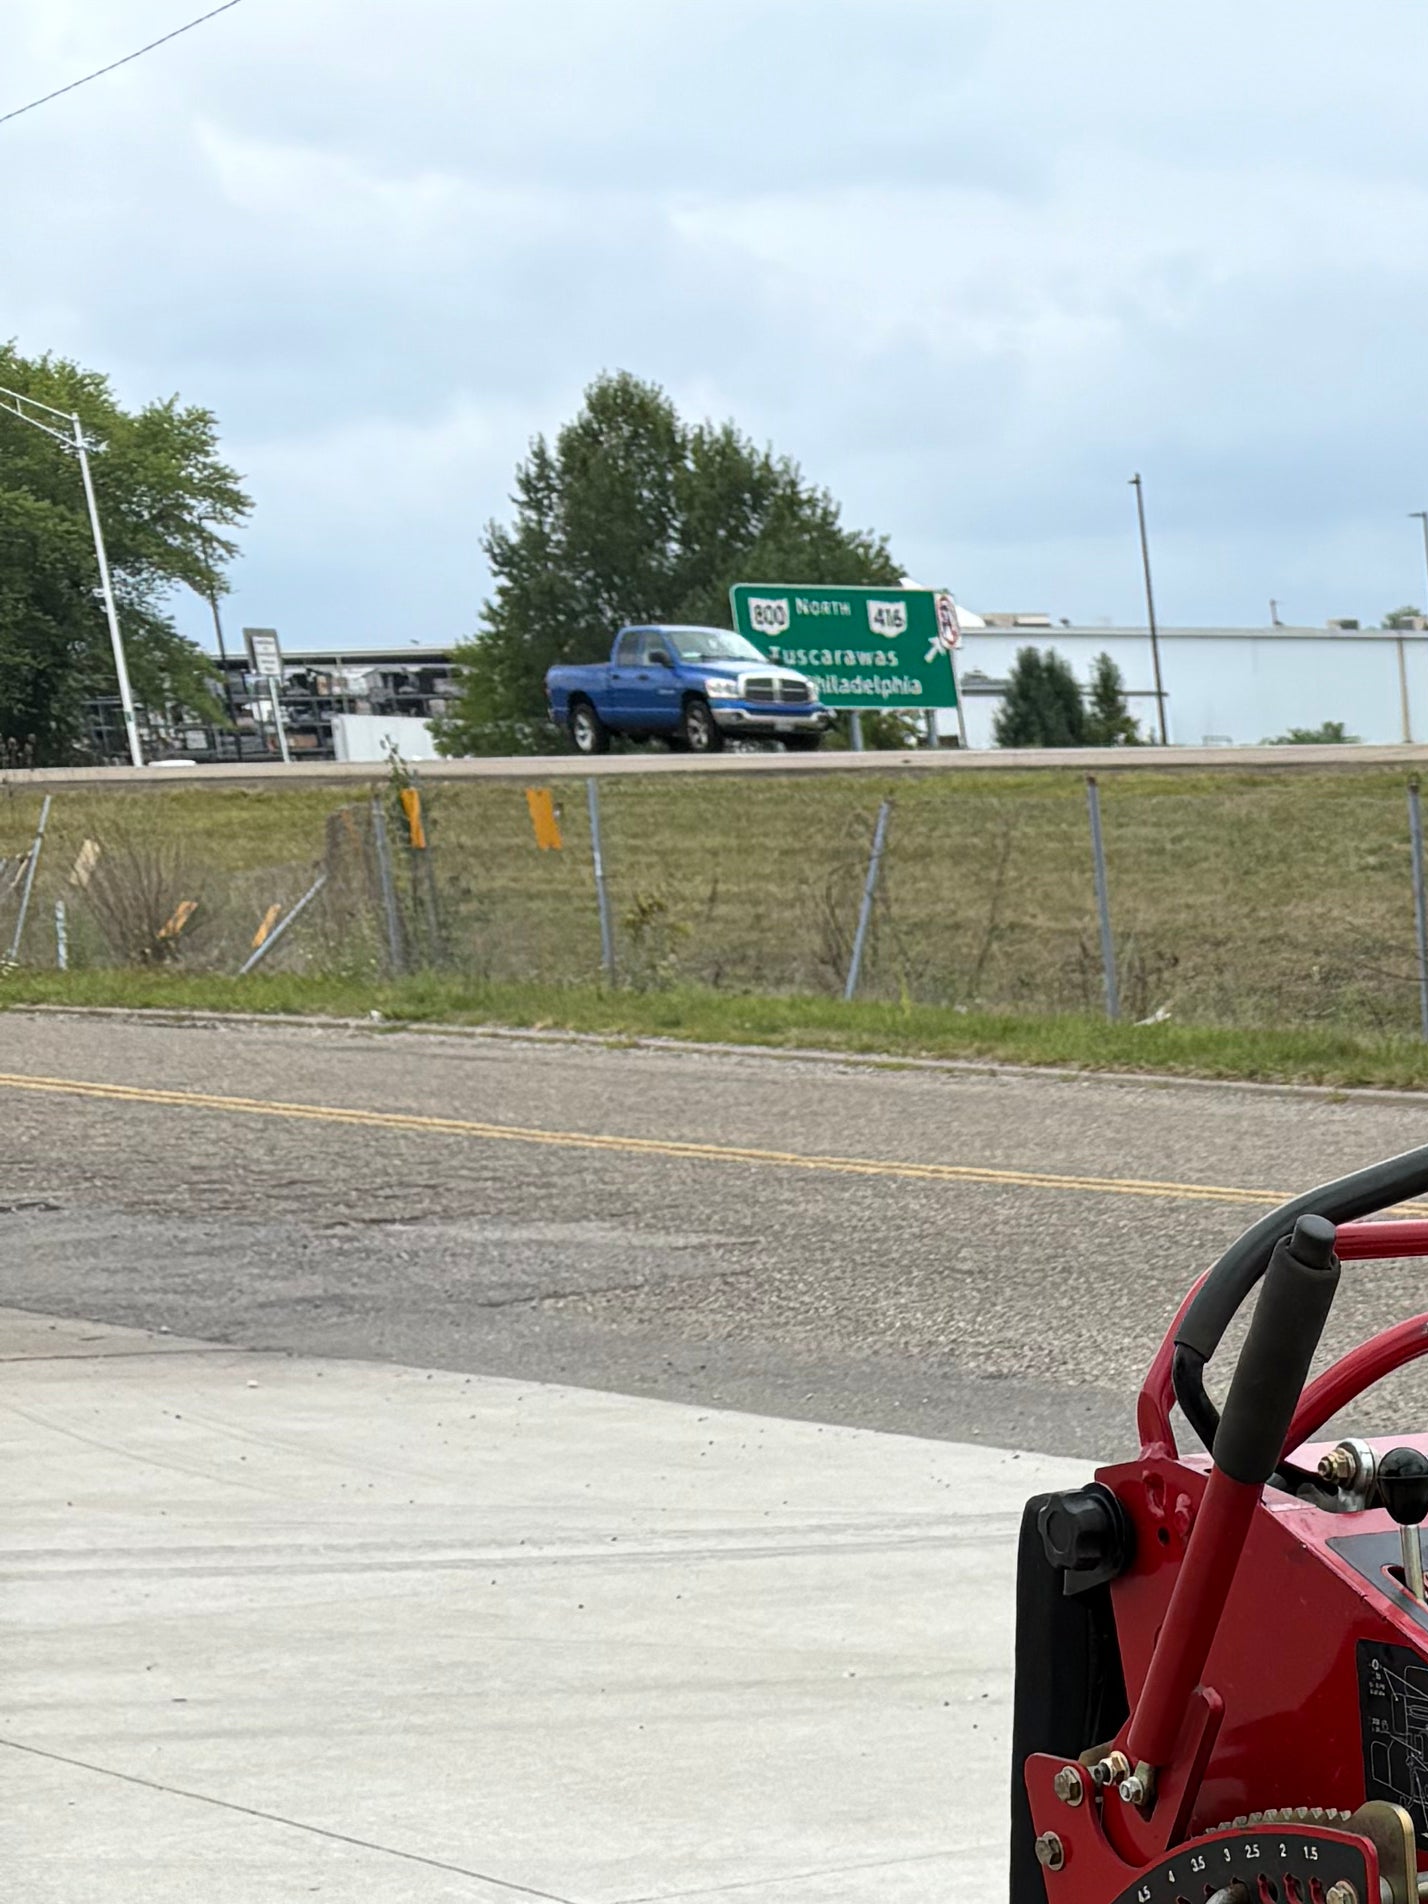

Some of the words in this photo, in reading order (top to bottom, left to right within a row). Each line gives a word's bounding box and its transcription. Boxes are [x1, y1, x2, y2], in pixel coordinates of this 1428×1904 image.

[754, 605, 785, 626] 800
[873, 608, 905, 628] 416
[768, 646, 899, 667] Tuscarawas
[1168, 1870, 1175, 1882] 4
[1190, 1855, 1206, 1872] 3.5
[1223, 1848, 1231, 1862] 3
[1244, 1844, 1261, 1859] 2.5
[1279, 1843, 1288, 1858] 2
[1303, 1846, 1319, 1861] 1.5
